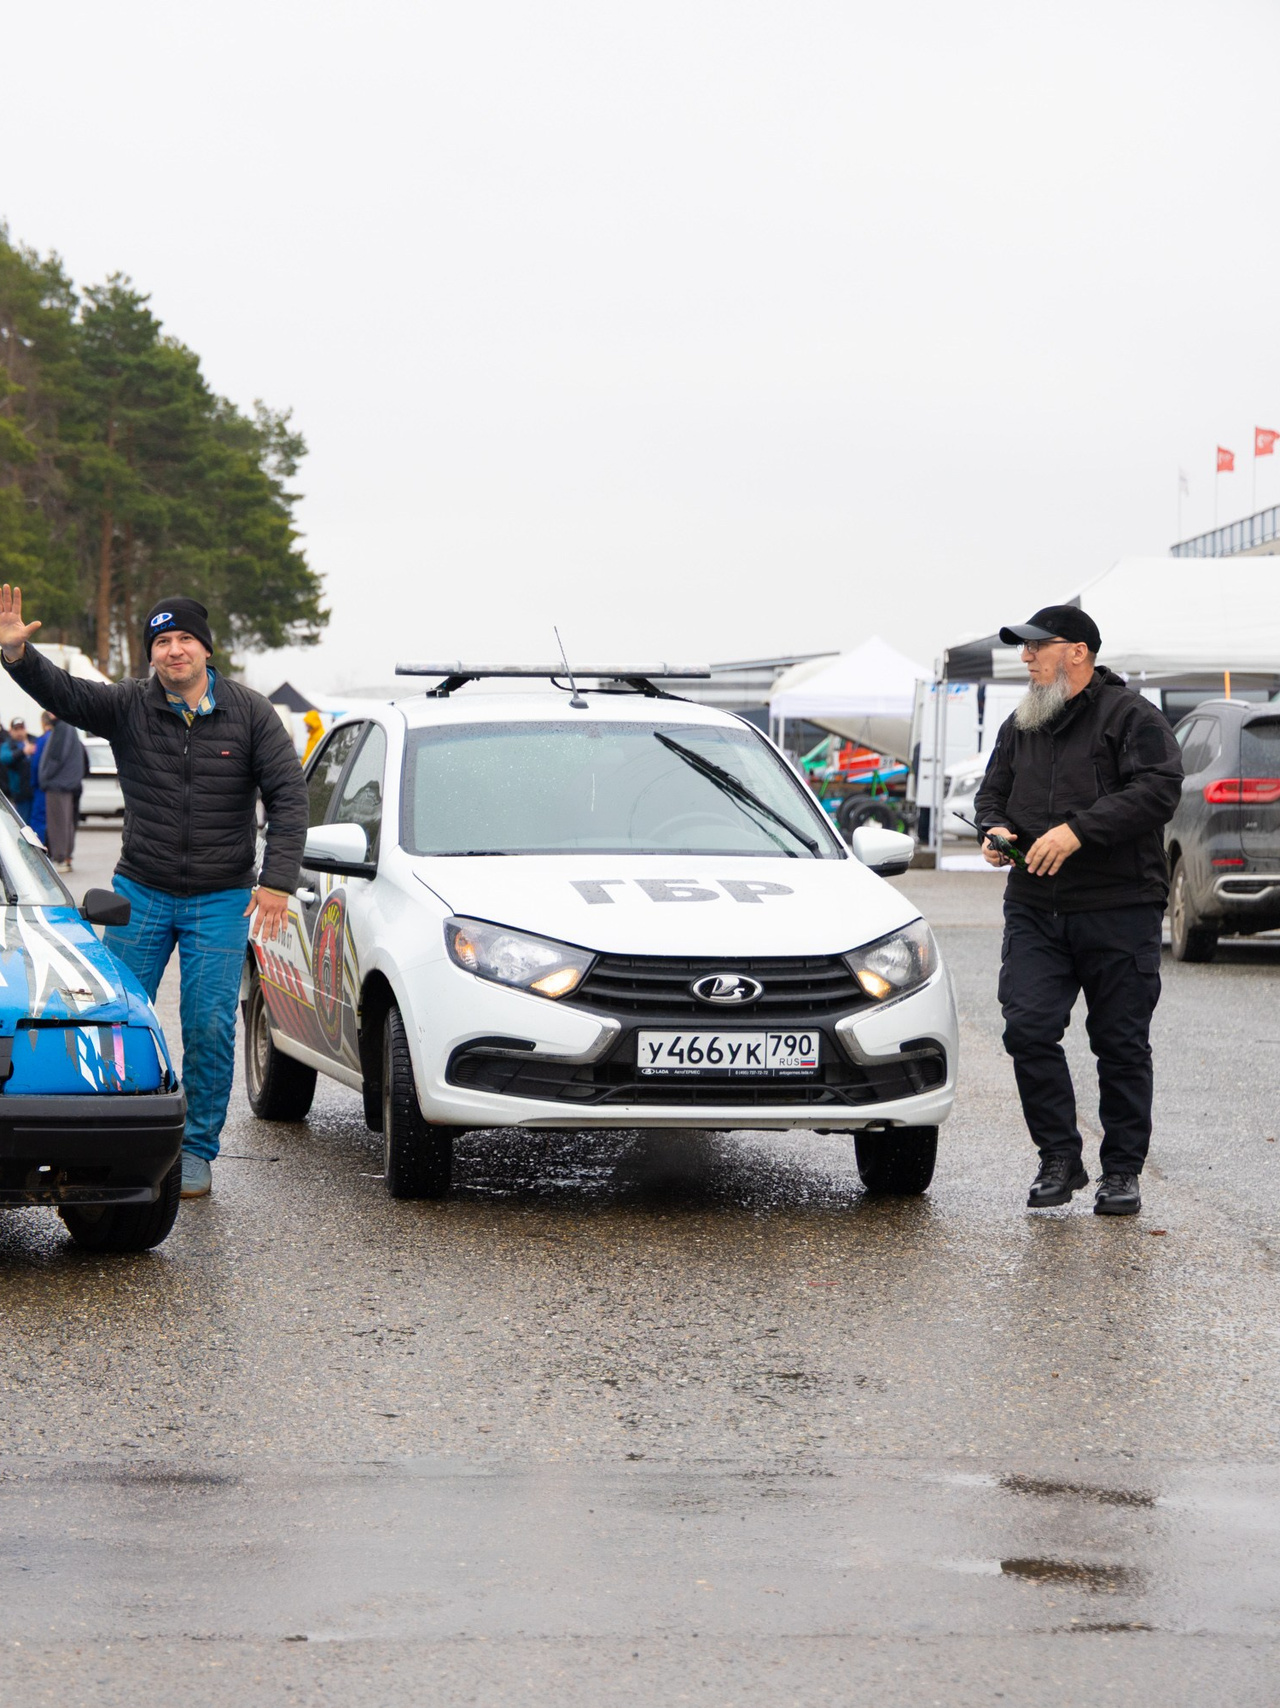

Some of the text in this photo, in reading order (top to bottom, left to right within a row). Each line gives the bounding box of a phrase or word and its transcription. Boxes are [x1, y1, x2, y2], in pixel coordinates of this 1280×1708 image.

[568, 879, 795, 904] ГБР
[648, 1034, 812, 1065] У466УК 790
[779, 1057, 800, 1066] RUS
